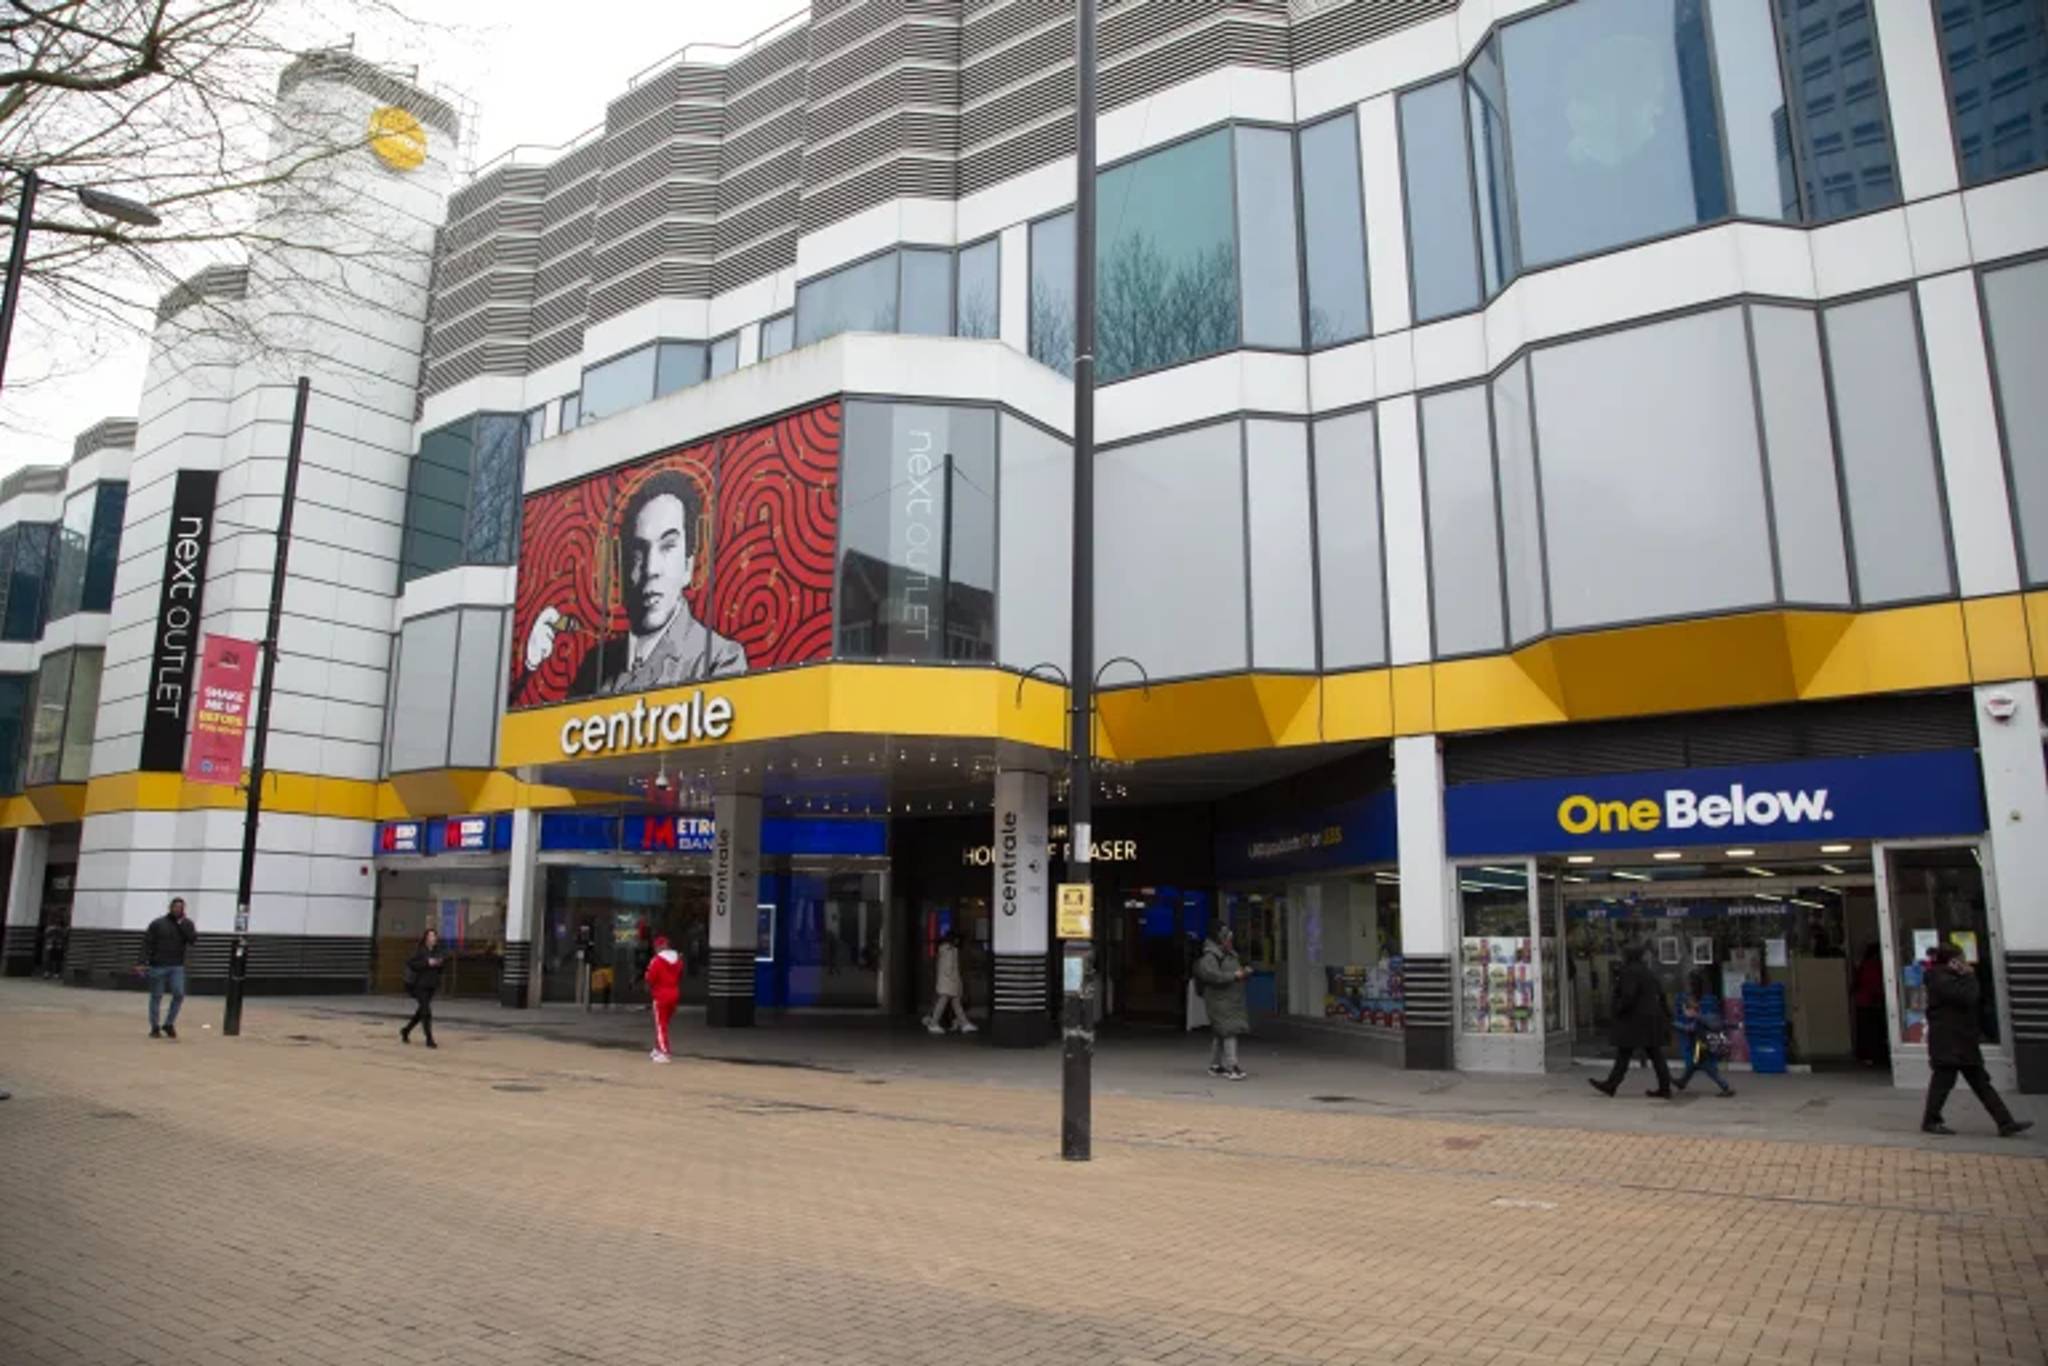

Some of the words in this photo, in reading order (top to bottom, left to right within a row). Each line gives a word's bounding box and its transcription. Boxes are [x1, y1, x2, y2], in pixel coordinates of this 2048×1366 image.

[905, 428, 933, 515] next
[169, 516, 203, 599] next
[902, 522, 931, 641] OUTLET
[156, 605, 191, 719] OUTLET
[561, 690, 733, 755] centrale
[644, 816, 715, 849] METR
[679, 837, 713, 850] BAN
[1557, 795, 1661, 834] One
[1664, 784, 1835, 829] Below.
[717, 829, 729, 917] centrale
[1001, 811, 1017, 917] centrale
[1063, 840, 1137, 862] FASER
